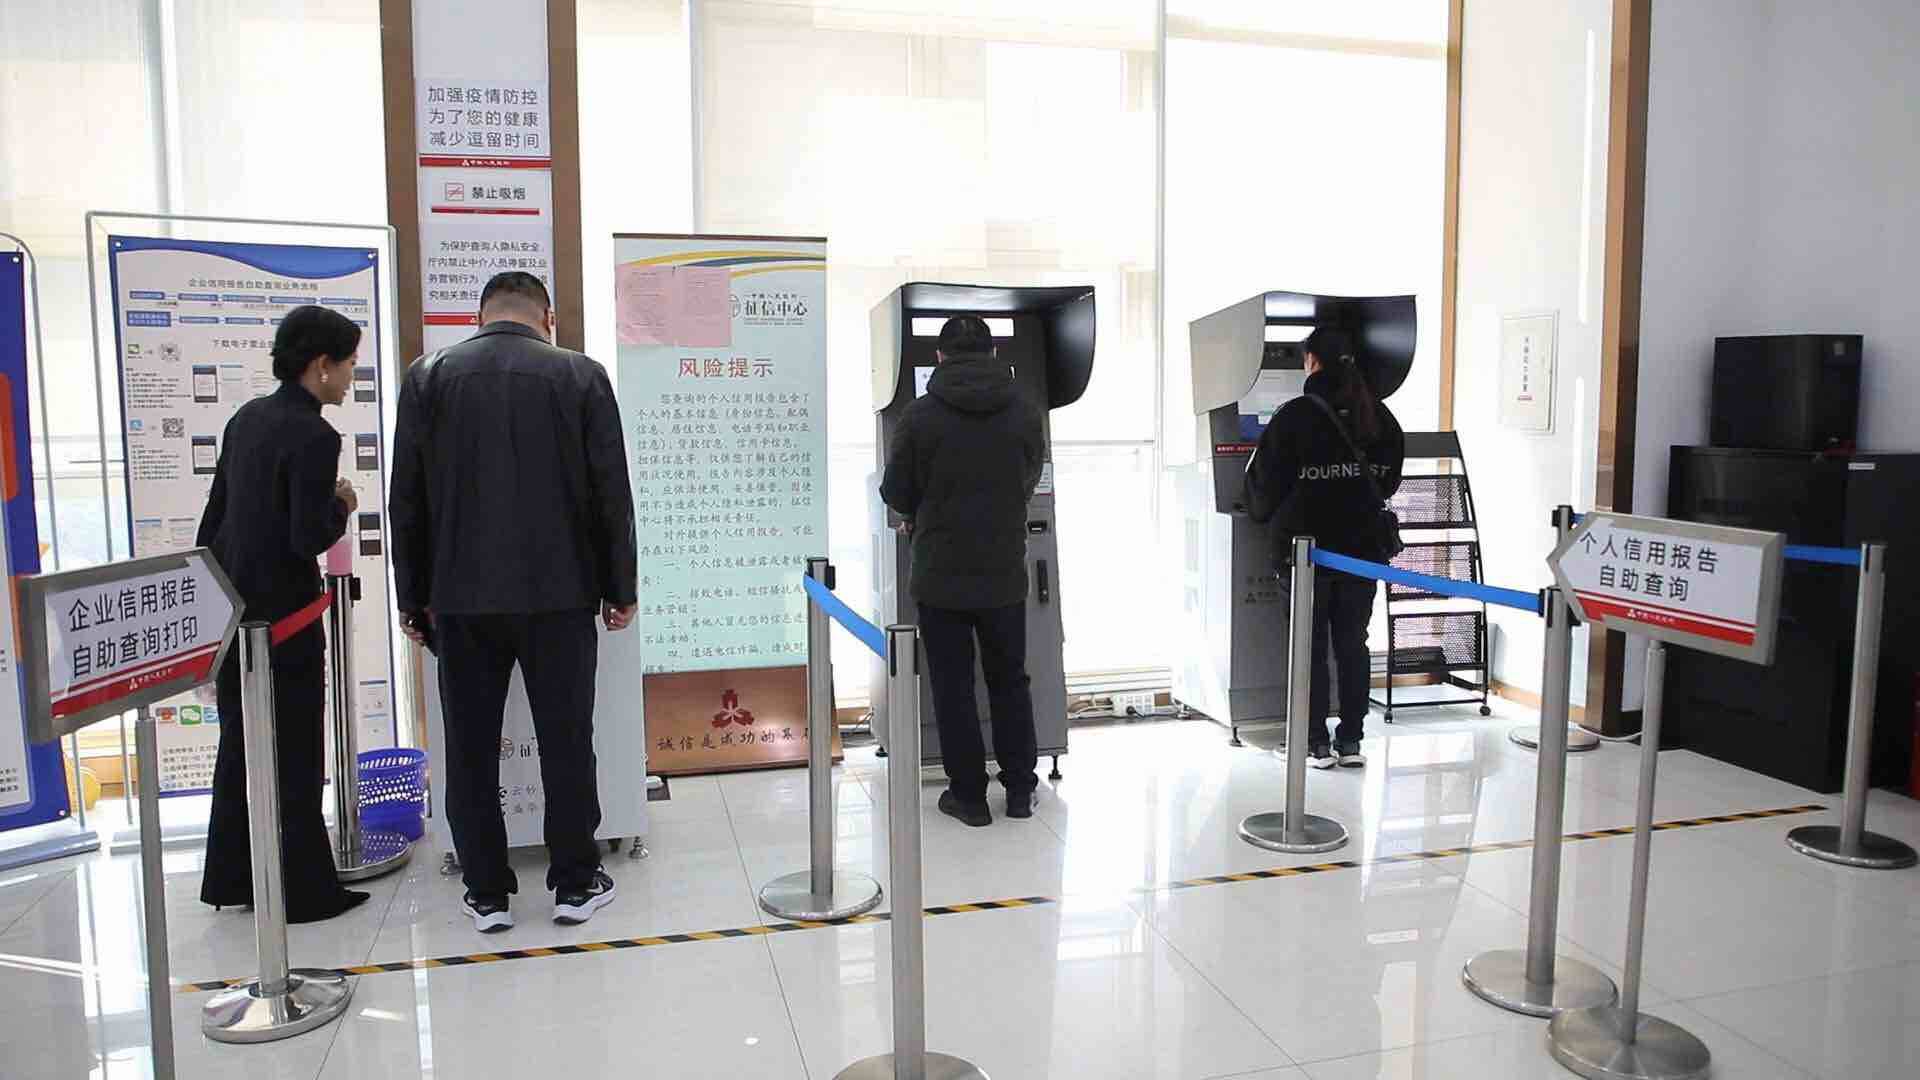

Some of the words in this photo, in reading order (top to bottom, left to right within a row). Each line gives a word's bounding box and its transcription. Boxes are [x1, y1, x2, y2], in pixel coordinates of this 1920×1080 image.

[428, 87, 538, 105] 加强疫情防控
[429, 109, 539, 128] 为了您的健康
[429, 131, 540, 149] 减少逗留时间
[472, 186, 526, 200] 禁止吸烟
[745, 300, 808, 316] 征信中心
[678, 358, 774, 378] 风险提示
[1579, 531, 1719, 574] 个人信用报告
[1599, 564, 1689, 601] 自助查询
[68, 575, 198, 632] 企业信用报告
[72, 614, 199, 680] 自助查询打印
